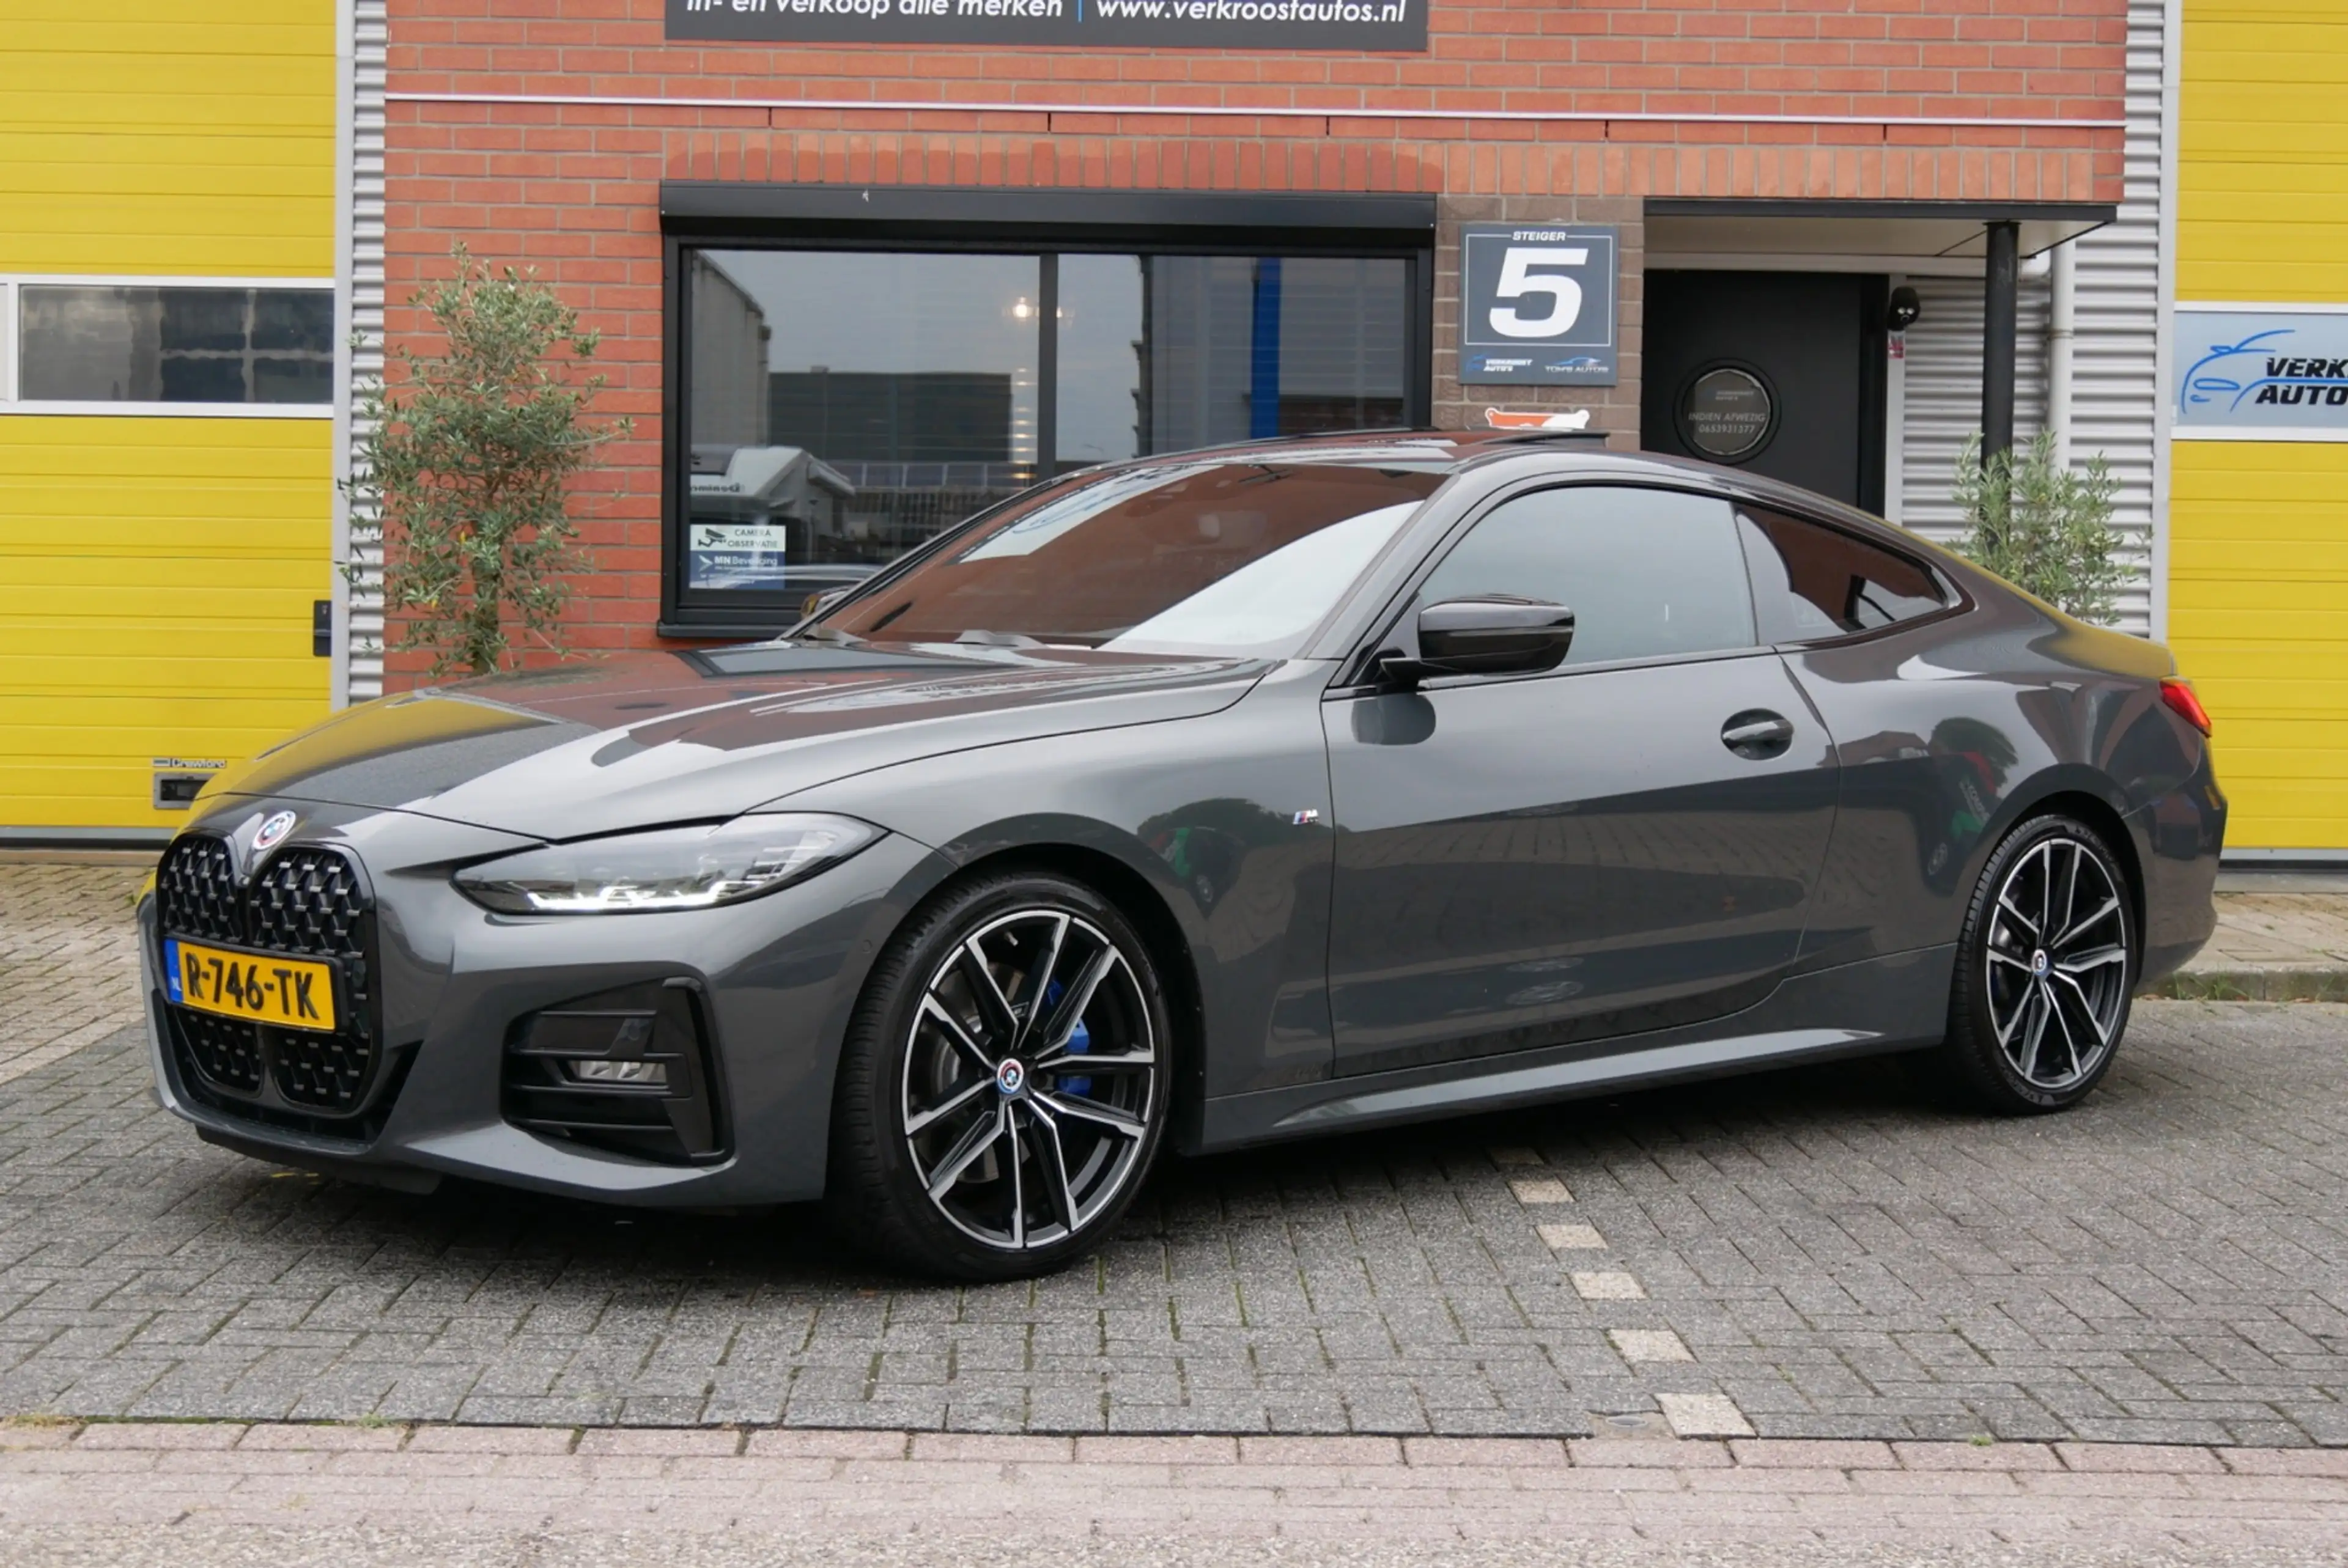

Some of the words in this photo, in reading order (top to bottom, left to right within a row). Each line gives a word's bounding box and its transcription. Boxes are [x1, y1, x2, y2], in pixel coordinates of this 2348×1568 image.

[732, 0, 766, 12] en
[775, 0, 890, 19] verkoop
[898, 0, 950, 15] alle
[958, 0, 1063, 17] merken
[1096, 0, 1406, 22] www.verkroostautos.nl
[1512, 231, 1567, 241] STEIGER
[1489, 248, 1589, 337] 5
[2267, 357, 2348, 378] VERK
[2255, 385, 2348, 405] AUTO
[727, 540, 778, 548] OBSERVATIE
[714, 555, 731, 565] MN
[185, 951, 319, 1020] R-746-TK
